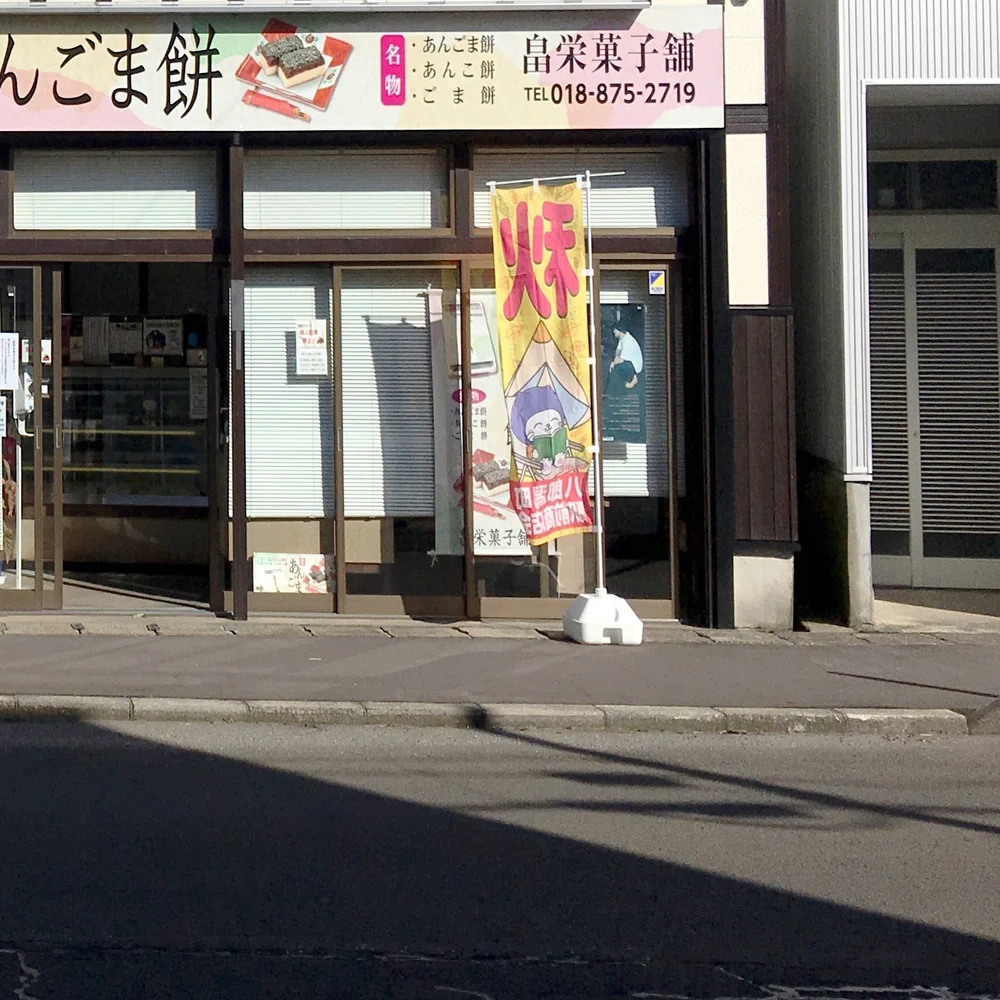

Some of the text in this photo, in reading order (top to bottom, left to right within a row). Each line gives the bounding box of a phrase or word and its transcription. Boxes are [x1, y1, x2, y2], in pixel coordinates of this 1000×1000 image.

[421, 34, 496, 56] あんごま餅
[522, 31, 695, 74] 畠栄菓子舗
[384, 43, 402, 98] 名物
[421, 60, 496, 80] あんこ餅
[421, 85, 496, 106] ごま餅
